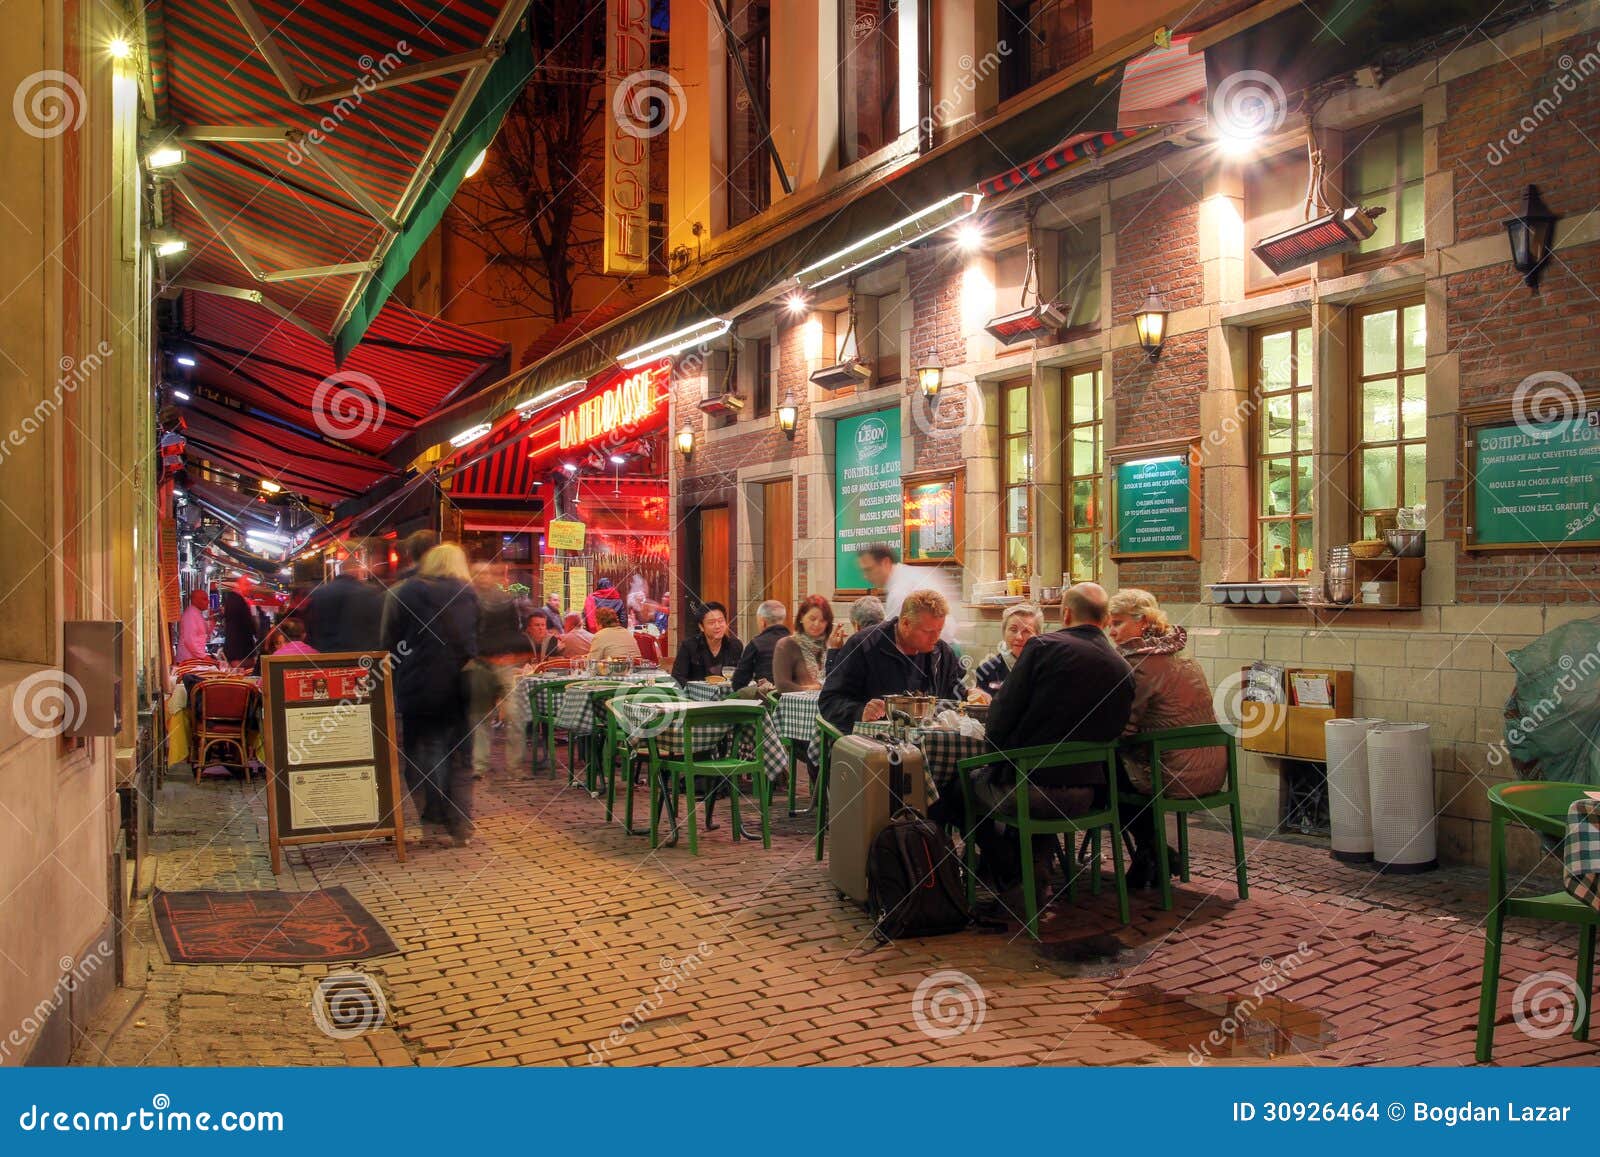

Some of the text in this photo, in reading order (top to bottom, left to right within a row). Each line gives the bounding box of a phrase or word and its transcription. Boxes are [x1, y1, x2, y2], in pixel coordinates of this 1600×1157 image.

[1480, 431, 1554, 451] COMPLET
[1528, 452, 1541, 460] AUX
[1542, 448, 1577, 459] CREVETTES
[1489, 474, 1593, 489] MOULES AU CHOIX AVEC FRITES
[1555, 502, 1590, 511] GRATUITE
